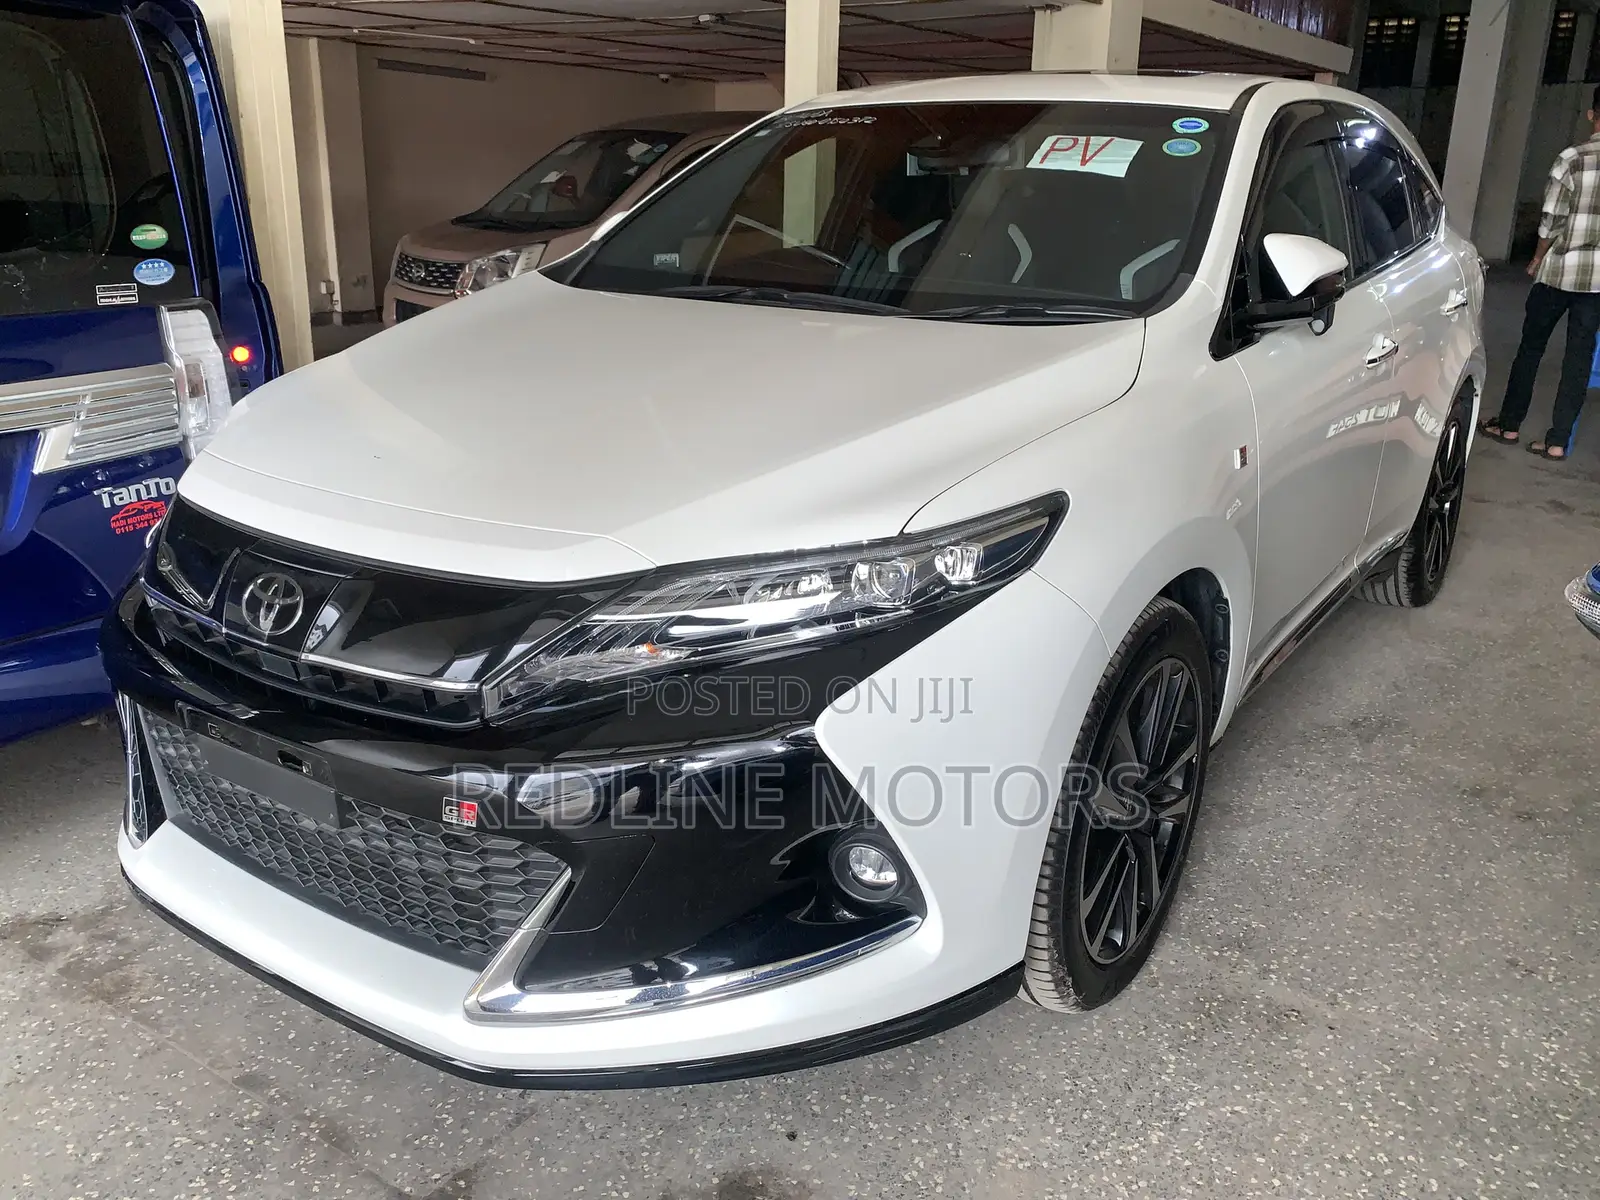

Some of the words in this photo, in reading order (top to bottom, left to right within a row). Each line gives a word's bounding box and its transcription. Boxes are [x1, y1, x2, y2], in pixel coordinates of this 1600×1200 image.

[1039, 136, 1115, 166] PV
[127, 512, 153, 524] MOTORS
[115, 524, 133, 534] 0115
[445, 805, 476, 820] GR
[444, 815, 476, 826] SPORT
